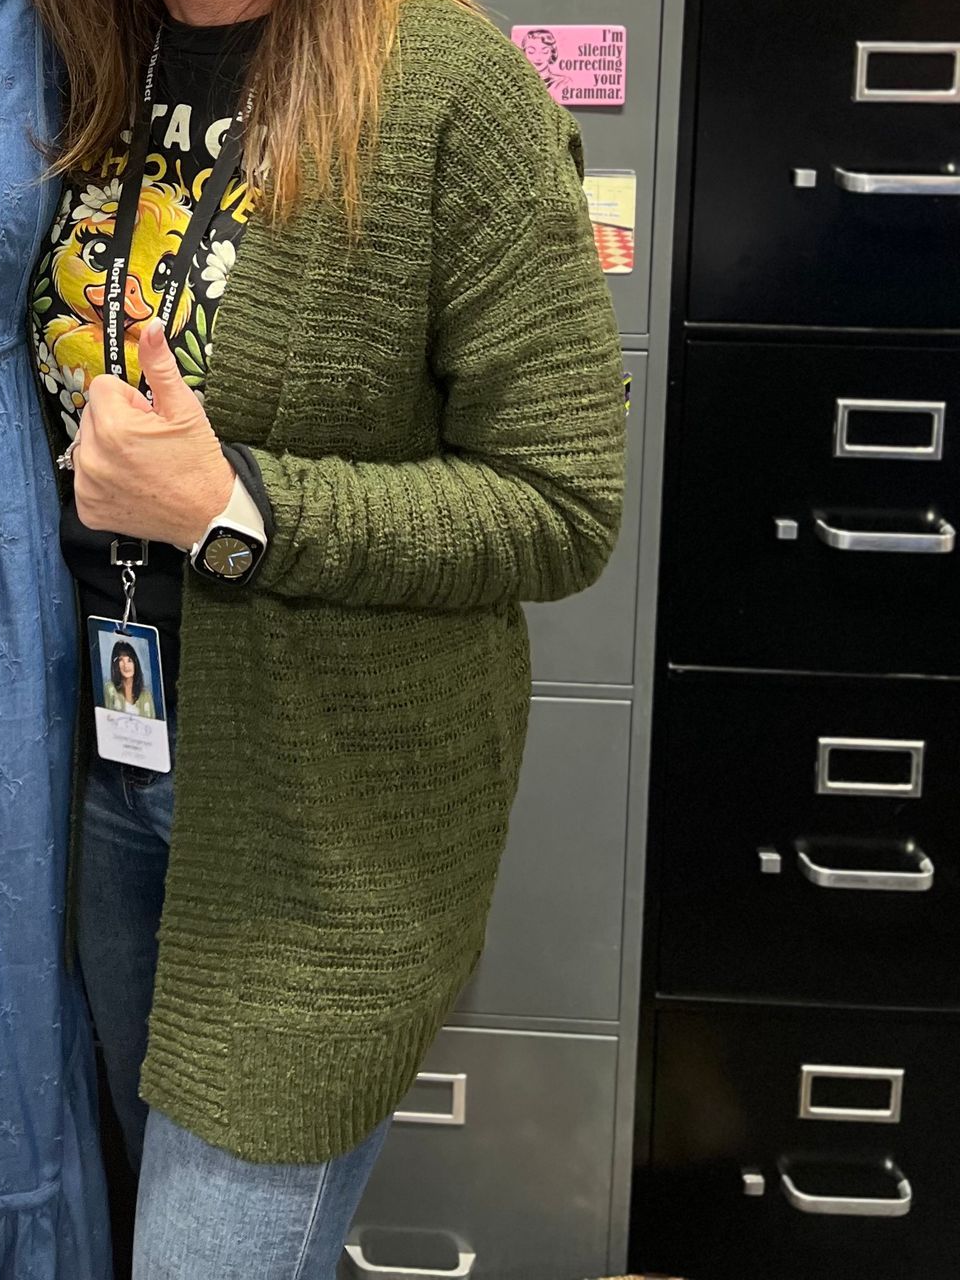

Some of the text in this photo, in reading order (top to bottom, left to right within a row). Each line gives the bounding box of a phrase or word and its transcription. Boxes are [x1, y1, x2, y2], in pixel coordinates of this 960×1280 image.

[602, 29, 623, 43] I'm
[577, 43, 623, 59] silently
[558, 58, 623, 73] correcting
[593, 73, 623, 87] your
[561, 86, 623, 101] grammar.
[108, 257, 125, 299] North
[160, 280, 179, 330] istrict
[106, 298, 122, 361] Sanpete
